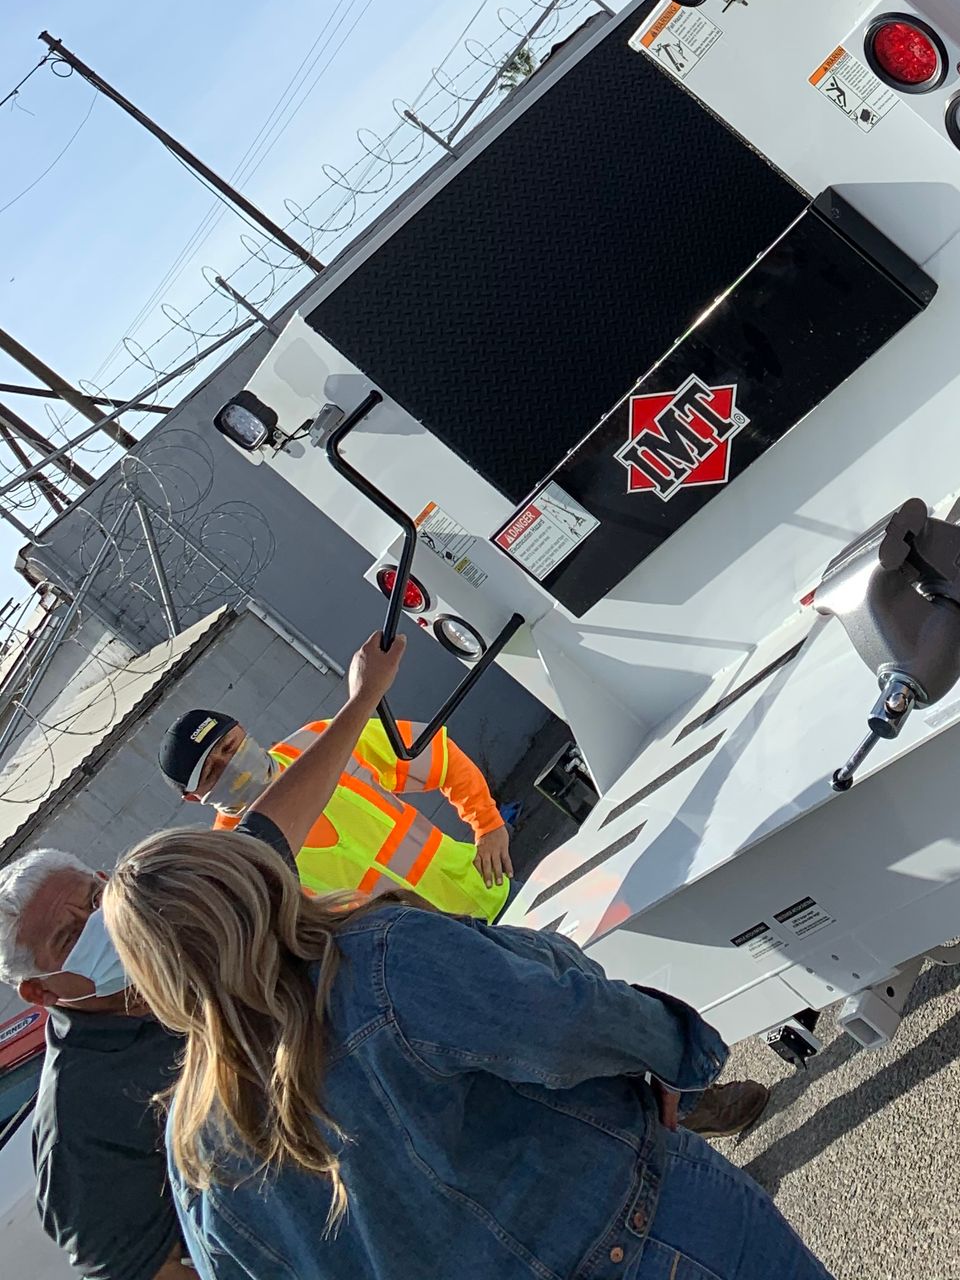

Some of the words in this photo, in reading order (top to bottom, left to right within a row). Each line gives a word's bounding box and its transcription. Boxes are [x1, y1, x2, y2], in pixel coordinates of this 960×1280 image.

[655, 4, 677, 32] WARNING
[673, 9, 686, 24] Hazard
[826, 48, 845, 67] WARNIN
[829, 64, 838, 73] FALL
[616, 376, 739, 499] IMT
[508, 529, 534, 554] Electrocution
[530, 518, 545, 533] Hazard
[509, 510, 536, 538] DANGER
[0, 1019, 28, 1039] ERNER
